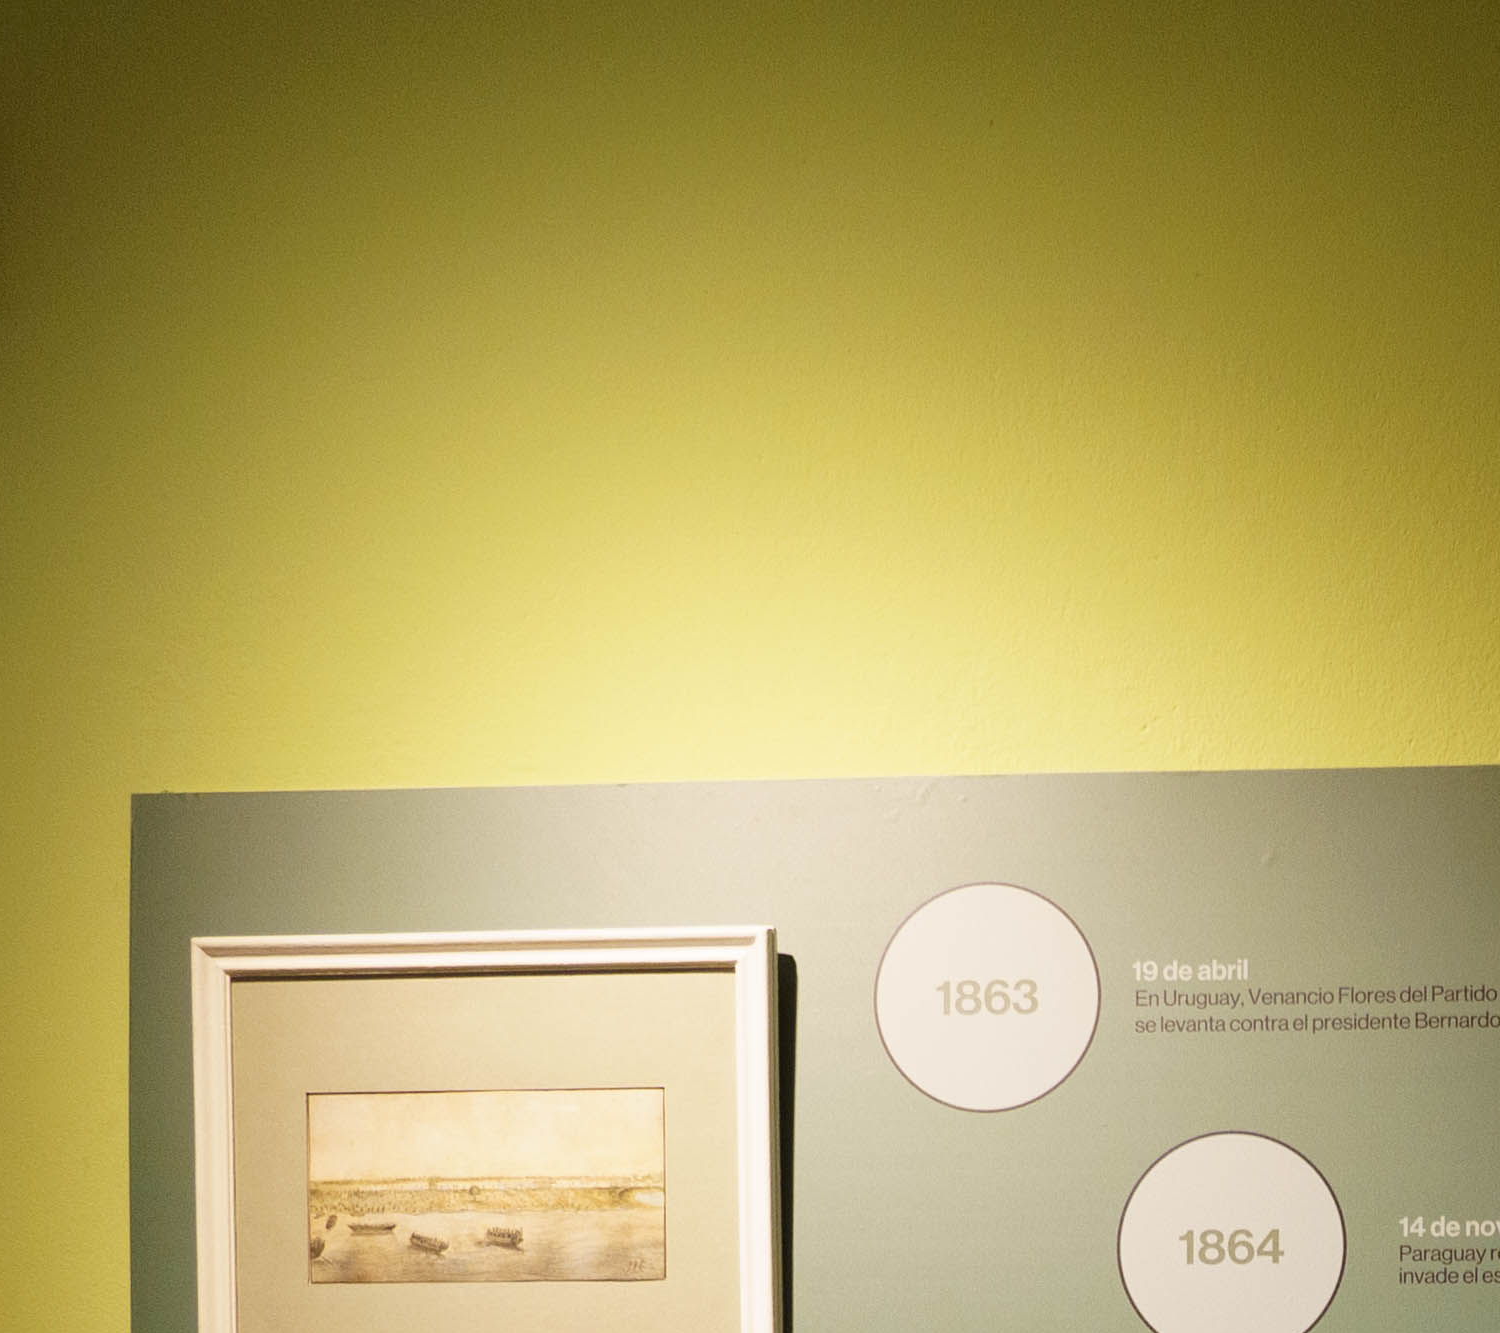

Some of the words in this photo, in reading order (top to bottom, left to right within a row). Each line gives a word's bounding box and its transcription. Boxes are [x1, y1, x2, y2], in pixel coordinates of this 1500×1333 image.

[1132, 960, 1159, 982] 19
[1162, 959, 1193, 982] de
[1197, 958, 1249, 982] abril
[935, 978, 1040, 1016] 1863
[1135, 989, 1160, 1008] En
[1162, 989, 1245, 1010] Uruguay,
[1247, 987, 1335, 1006] Venancio
[1337, 986, 1397, 1005] Flores
[1399, 985, 1428, 1004] del
[1431, 983, 1499, 1003] Partido
[1398, 1215, 1427, 1238] 14
[1429, 1215, 1461, 1238] de
[1178, 1228, 1286, 1266] 1864
[1398, 1244, 1487, 1265] Paraguay
